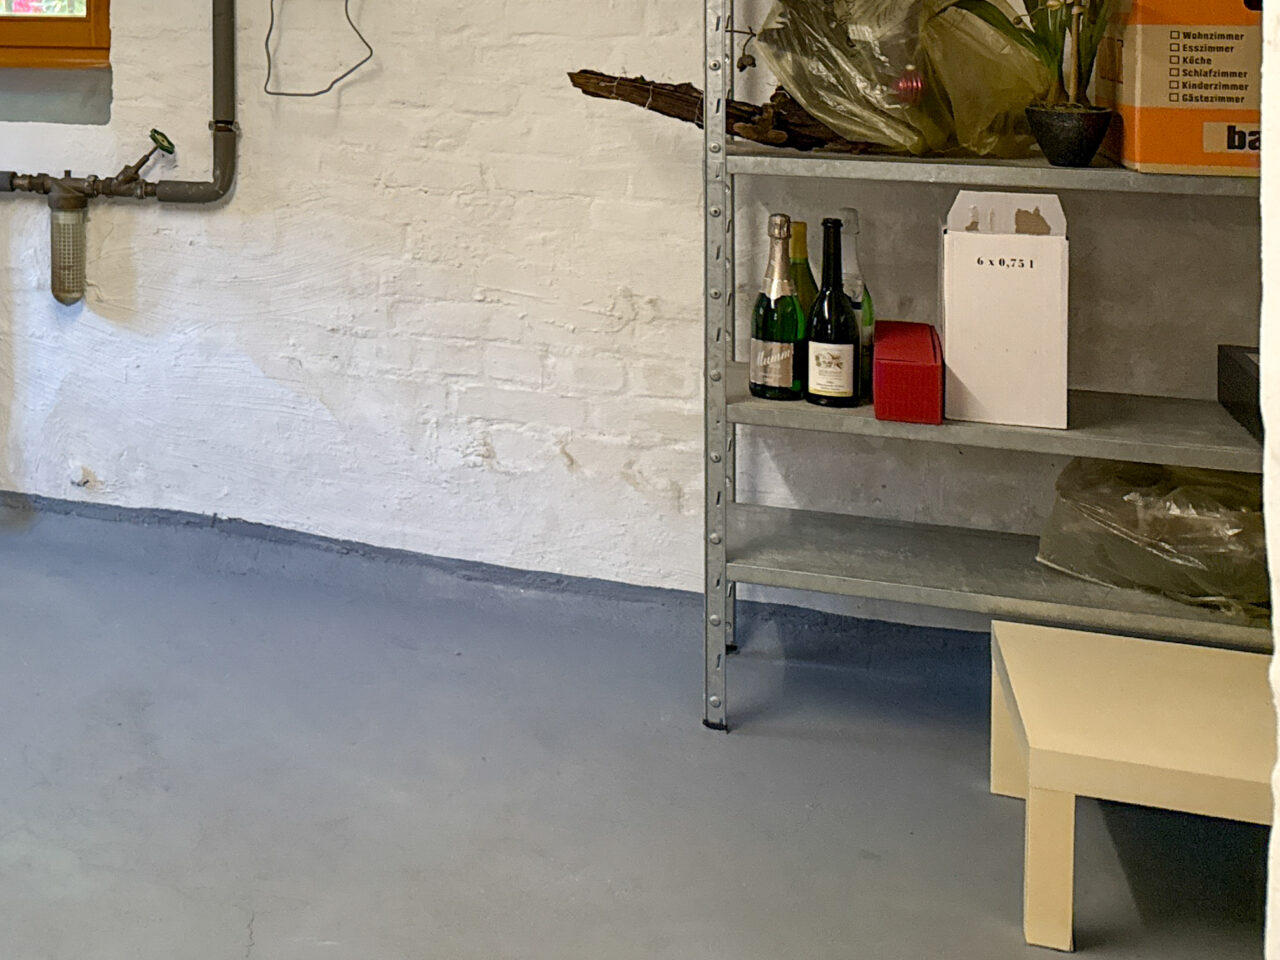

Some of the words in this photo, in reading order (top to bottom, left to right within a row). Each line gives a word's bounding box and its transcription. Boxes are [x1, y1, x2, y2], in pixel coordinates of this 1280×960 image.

[1182, 31, 1245, 41] Wohnzimmer
[1182, 43, 1235, 53] Esszimmer
[1182, 56, 1212, 65] Küche
[1182, 68, 1248, 78] Schlafzimmer
[1182, 81, 1249, 91] Kinderzimmer
[1182, 93, 1245, 103] Gästezimmer
[976, 256, 984, 265] 6
[998, 258, 1025, 268] 0,75
